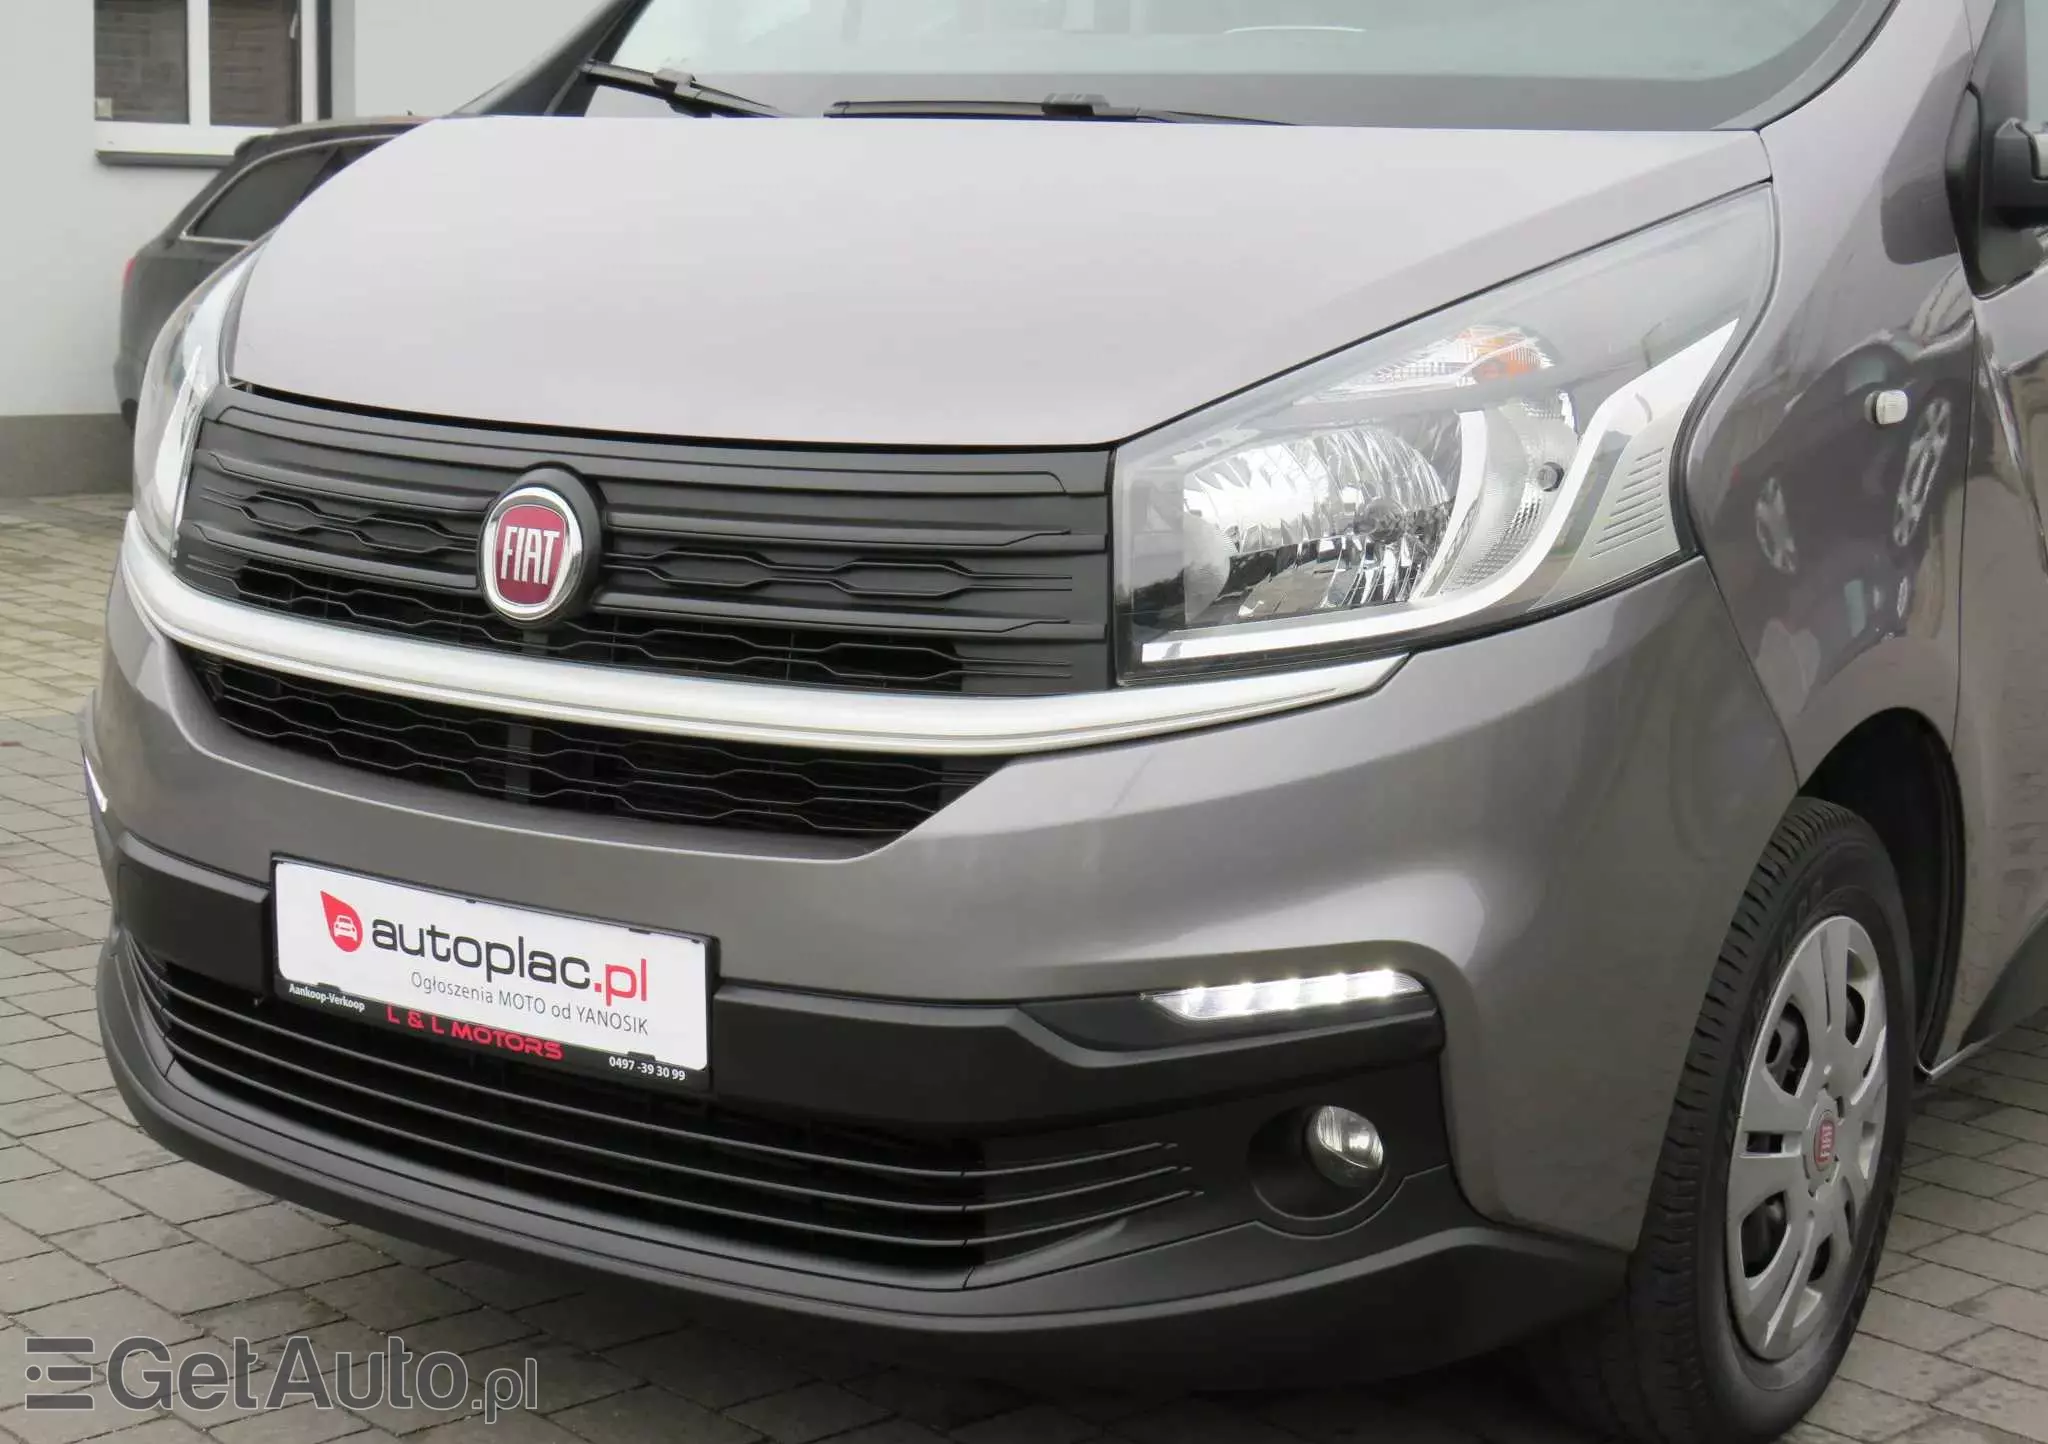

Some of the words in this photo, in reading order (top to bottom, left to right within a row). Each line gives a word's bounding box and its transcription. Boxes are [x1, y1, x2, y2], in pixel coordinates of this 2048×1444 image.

[501, 526, 560, 585] FIAT
[372, 918, 648, 1006] autoplac.pl
[288, 983, 365, 1013] Aankoop-Verkoop
[411, 971, 494, 1004] Ogłoszenia
[498, 990, 546, 1015] MOTO
[550, 1002, 572, 1020] od
[575, 1006, 649, 1036] YANOSIK
[387, 1004, 400, 1024] L
[407, 1010, 425, 1029] &
[431, 1015, 445, 1034] L
[451, 1021, 563, 1060] MOTORS
[608, 1055, 635, 1071] 0497
[656, 1066, 670, 1078] 30
[671, 1068, 686, 1081] 99
